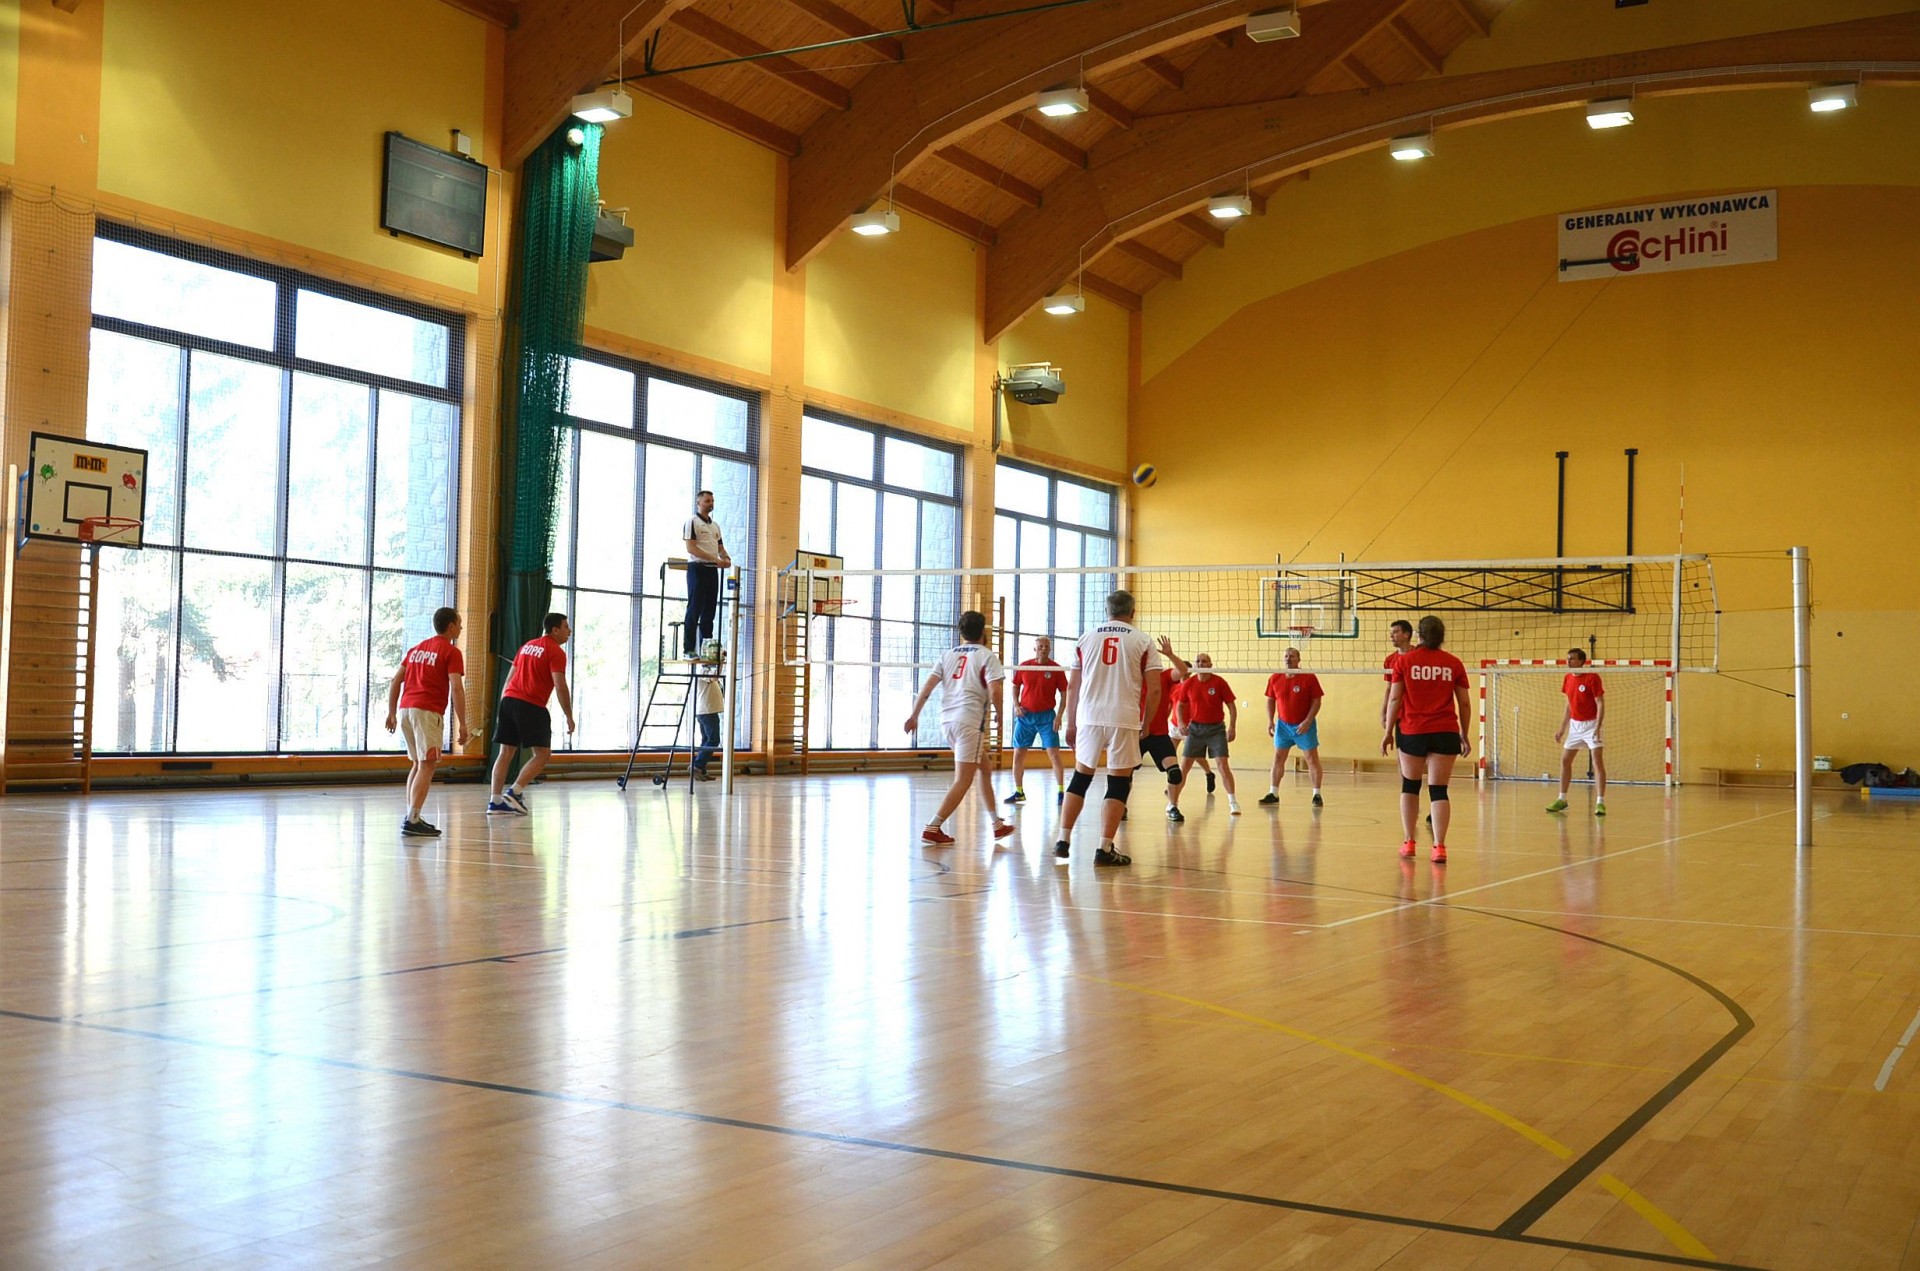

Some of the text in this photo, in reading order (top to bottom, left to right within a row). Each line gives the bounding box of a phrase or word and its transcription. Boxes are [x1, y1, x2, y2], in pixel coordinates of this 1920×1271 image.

[1565, 195, 1770, 231] GENERALNY WYKONAWCA
[1097, 626, 1132, 634] BESKIDY
[409, 649, 438, 667] GOPR
[520, 644, 544, 658] GOPR
[1102, 637, 1120, 666] 6
[1411, 665, 1452, 681] GOPR
